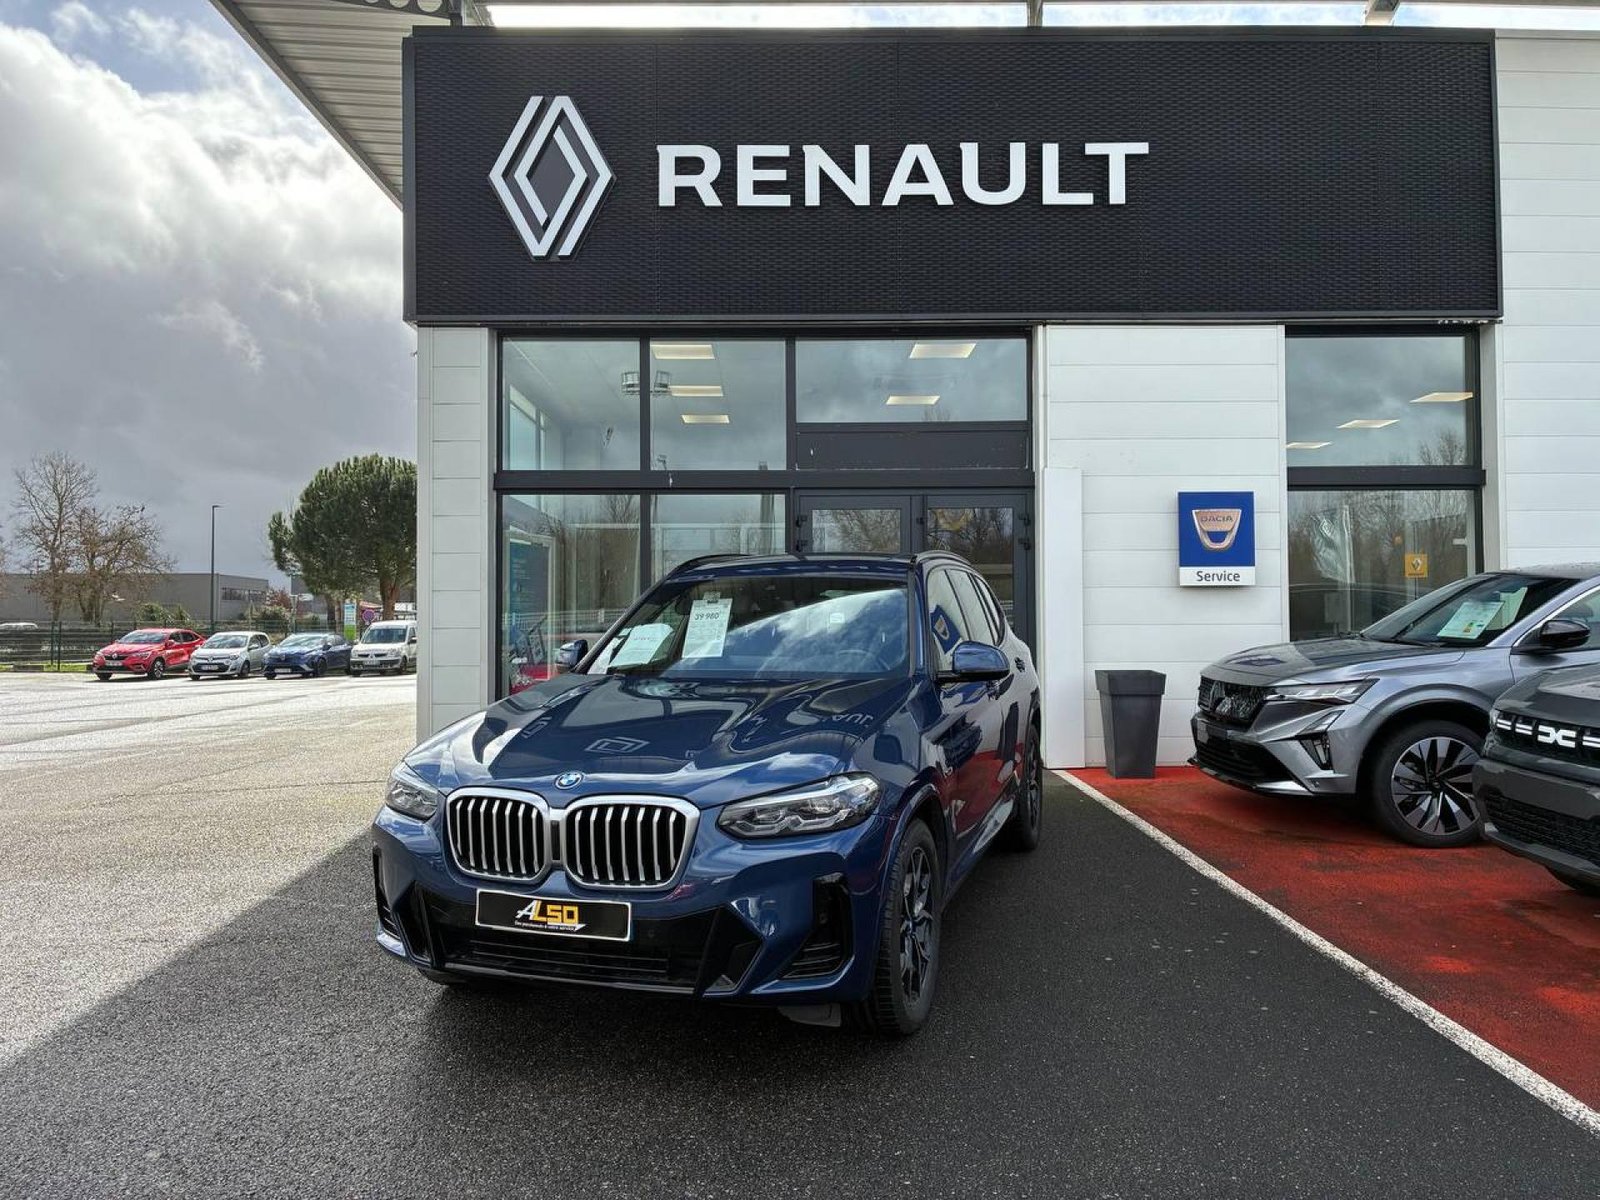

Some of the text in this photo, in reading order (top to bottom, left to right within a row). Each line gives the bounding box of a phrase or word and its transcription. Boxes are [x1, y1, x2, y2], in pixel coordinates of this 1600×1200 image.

[657, 142, 1150, 207] RENAULT
[1201, 515, 1234, 523] DACIA
[1196, 570, 1241, 582] Service
[515, 900, 579, 926] ALSO
